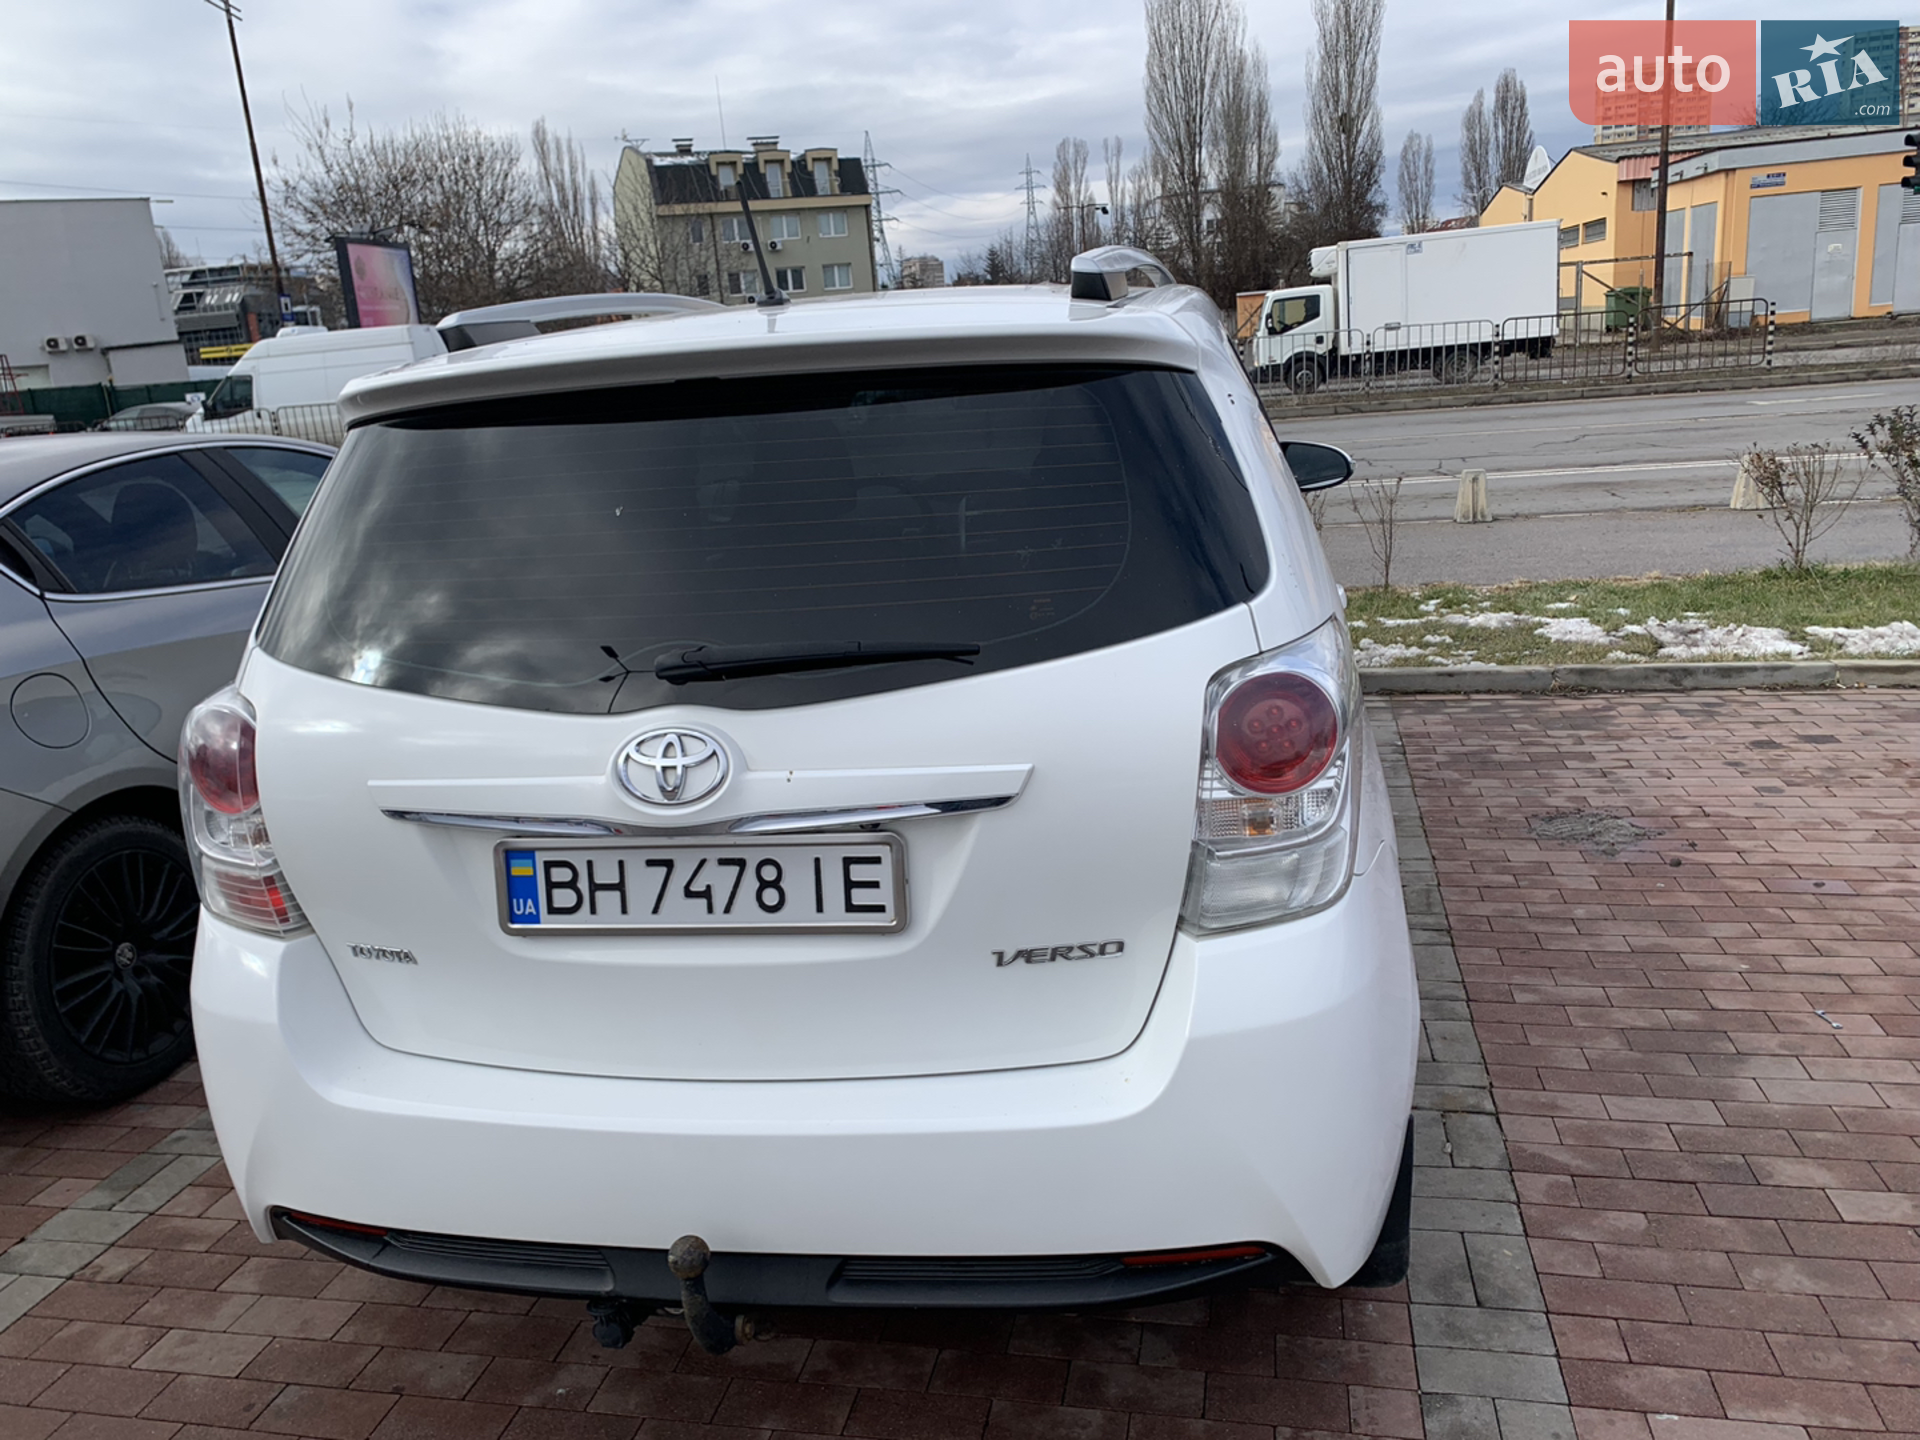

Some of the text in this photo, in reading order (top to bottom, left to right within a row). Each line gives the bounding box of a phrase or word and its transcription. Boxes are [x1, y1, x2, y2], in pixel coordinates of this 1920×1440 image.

[543, 856, 887, 915] BH 7478 IE
[513, 898, 536, 915] UA
[346, 942, 418, 965] TOYOTA
[991, 939, 1125, 967] VERSO
